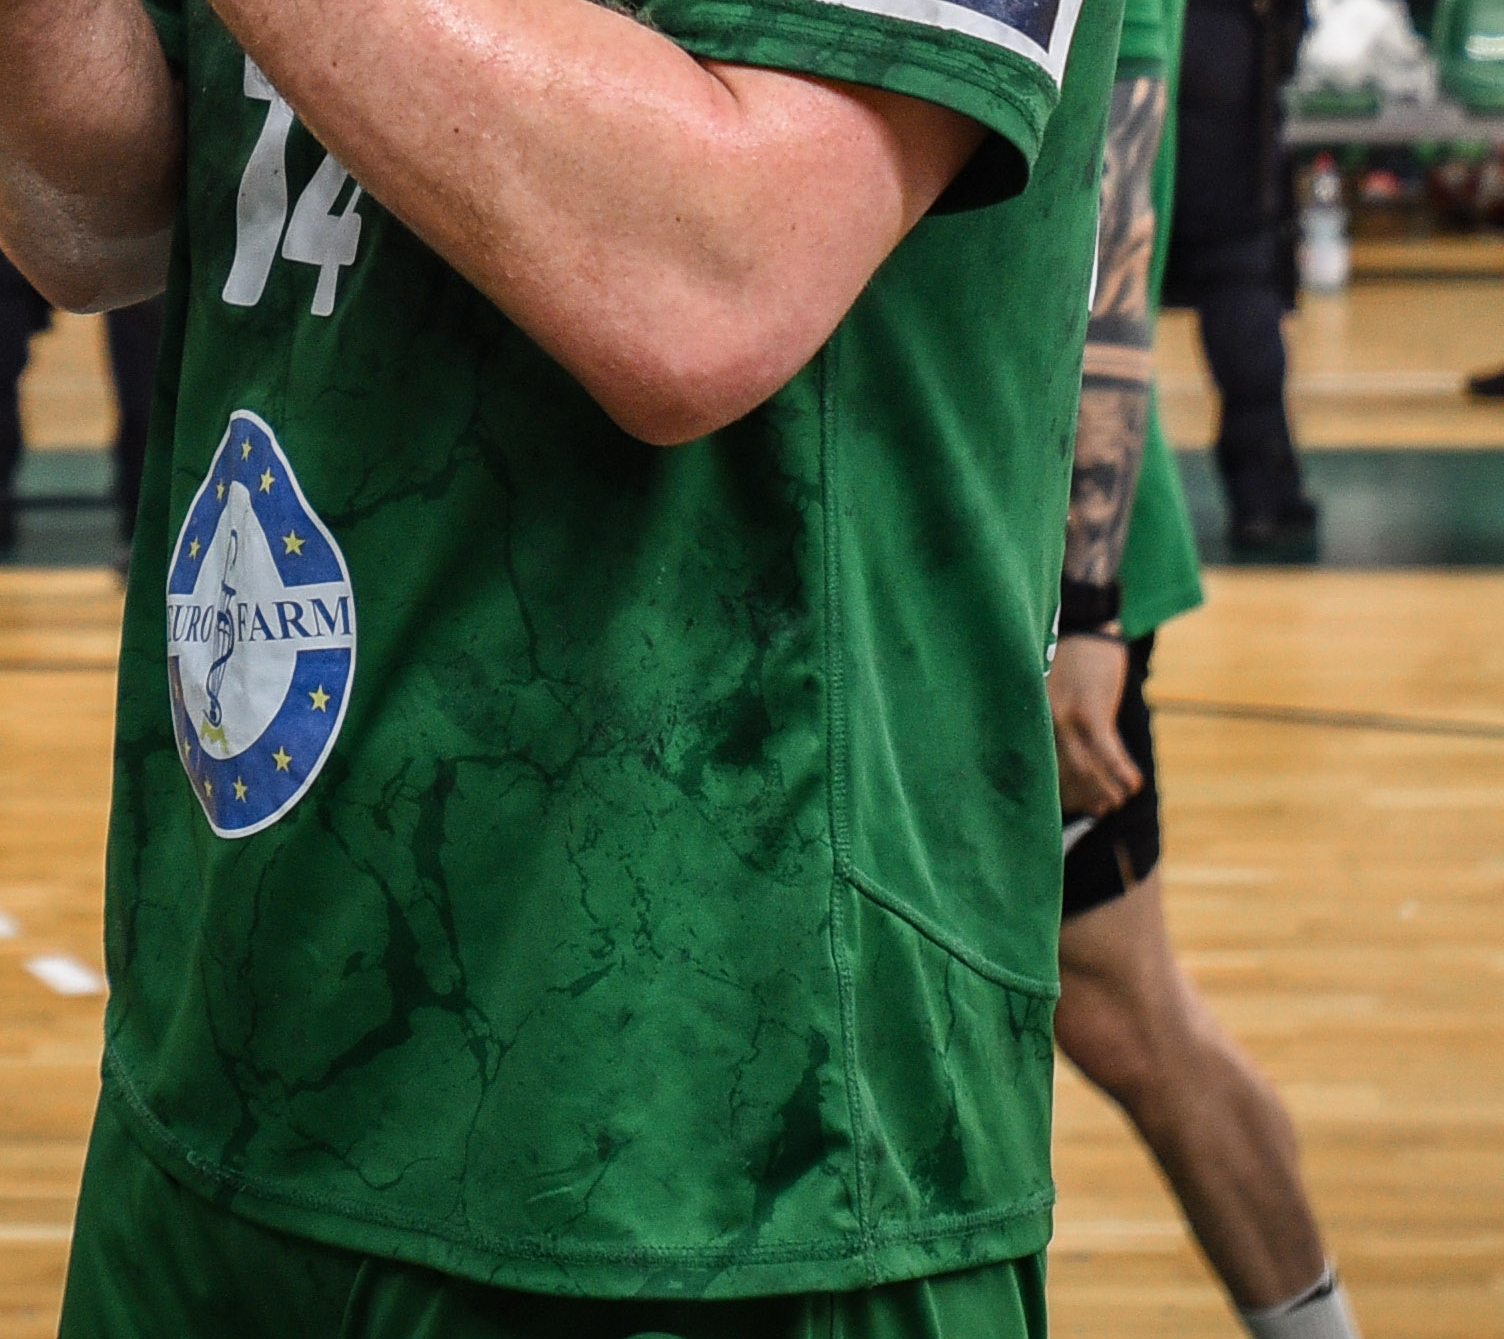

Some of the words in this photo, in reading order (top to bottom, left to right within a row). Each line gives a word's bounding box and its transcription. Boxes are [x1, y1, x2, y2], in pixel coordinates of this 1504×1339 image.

[221, 51, 362, 317] 14
[168, 603, 212, 646] EURO
[236, 595, 351, 644] FARM
